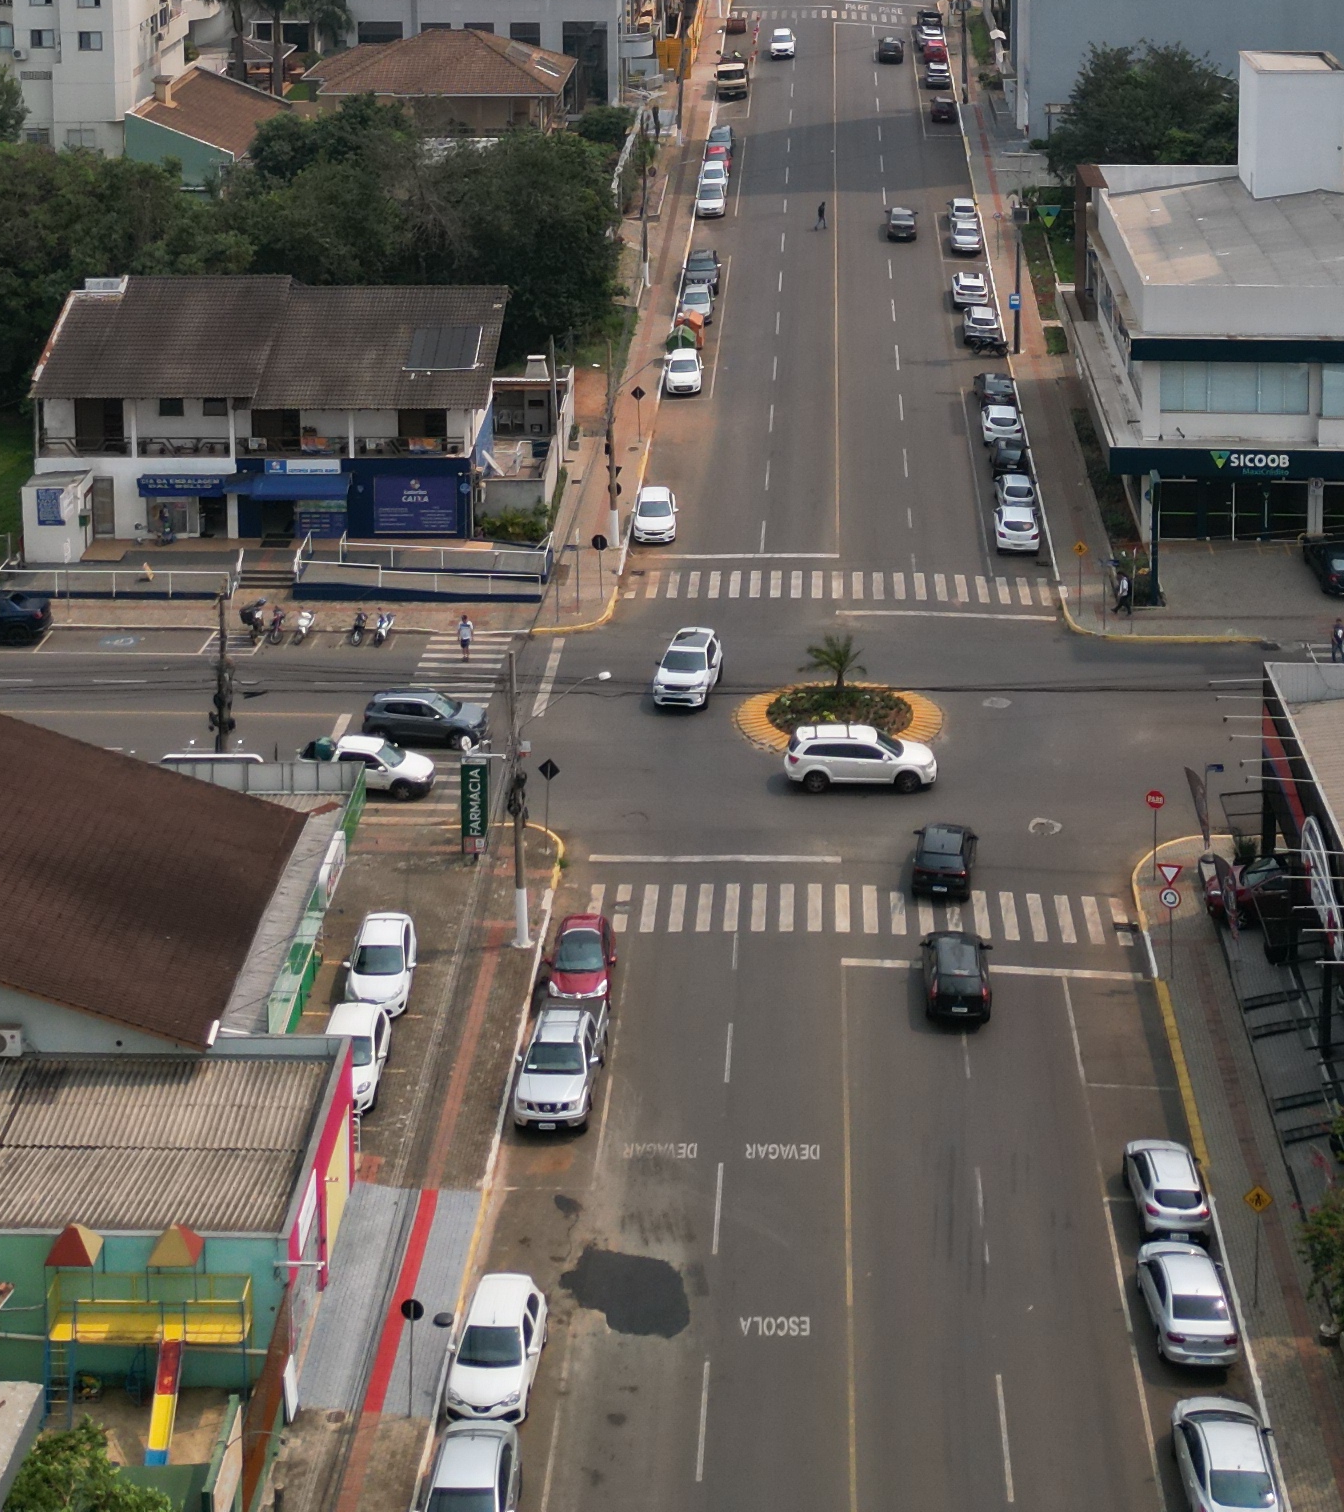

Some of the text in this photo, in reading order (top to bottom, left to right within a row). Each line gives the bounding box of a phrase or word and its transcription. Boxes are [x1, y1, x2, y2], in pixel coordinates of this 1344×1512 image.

[1229, 453, 1290, 468] SICOOB
[401, 495, 429, 503] CAIXA
[623, 1142, 821, 1160] DEVAGAR DEVAGAR
[739, 1316, 811, 1336] ESCOLA
